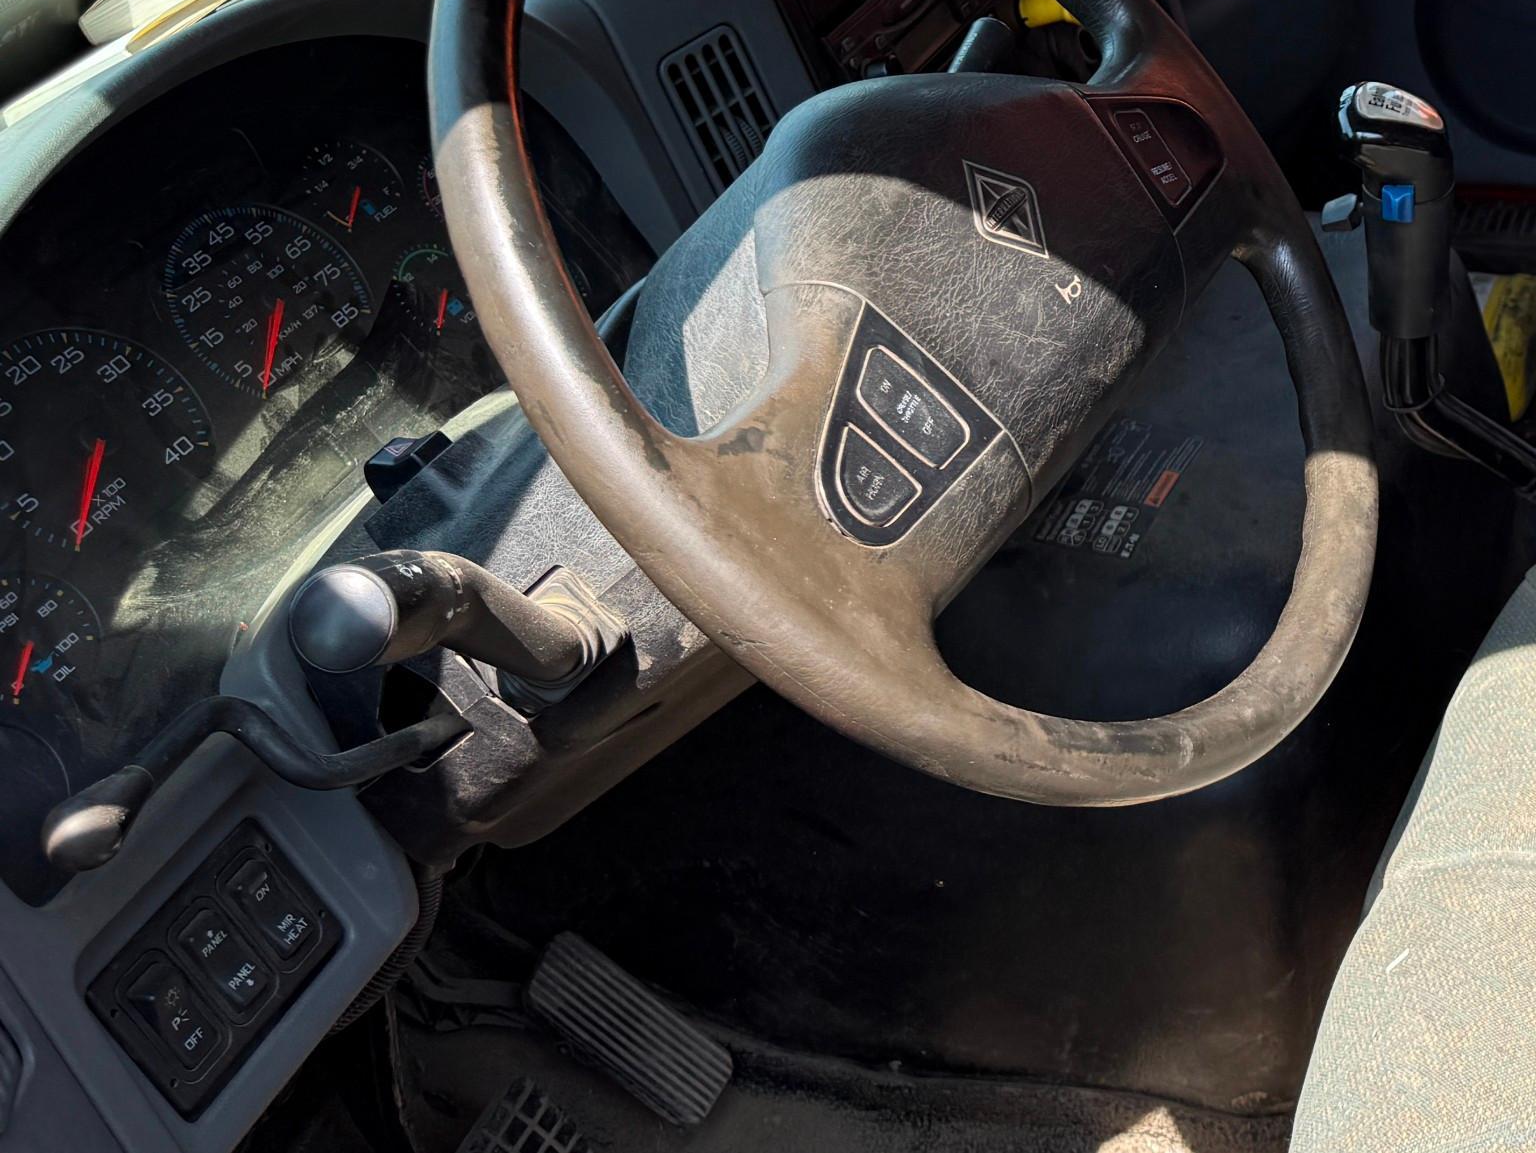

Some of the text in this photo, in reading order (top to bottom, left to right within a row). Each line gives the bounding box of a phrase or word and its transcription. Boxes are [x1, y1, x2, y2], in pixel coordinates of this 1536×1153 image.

[317, 153, 333, 167] 1/2
[347, 155, 364, 171] 3/4
[314, 180, 329, 193] 1/4
[373, 205, 398, 223] FUEL
[208, 222, 235, 247] 45
[244, 221, 274, 246] 55
[285, 235, 312, 260] 65
[181, 250, 213, 275] 35
[226, 275, 243, 289] 60
[313, 263, 342, 287] 75
[181, 286, 212, 313] 25
[227, 295, 243, 310] 40
[241, 318, 258, 334] 20
[331, 302, 360, 329] 85
[200, 327, 225, 348] 15
[5, 355, 42, 386] 20
[50, 346, 85, 375] 25
[96, 354, 132, 385] 30
[233, 359, 254, 379] 5
[276, 350, 304, 378] MPH
[0, 400, 13, 418] 5
[141, 388, 175, 417] 35
[0, 439, 15, 462] 0
[165, 435, 195, 465] 40
[101, 476, 127, 499] 100
[16, 492, 40, 513] 5
[91, 494, 128, 526] RPM
[37, 600, 58, 618] 80
[55, 632, 80, 653] 100
[52, 665, 77, 682] OIL
[255, 883, 270, 902] ON
[276, 913, 296, 933] MIR
[284, 916, 309, 946] HEAT
[202, 930, 228, 958] PANEL
[227, 961, 256, 991] PANEL
[184, 1025, 205, 1051] OFF
